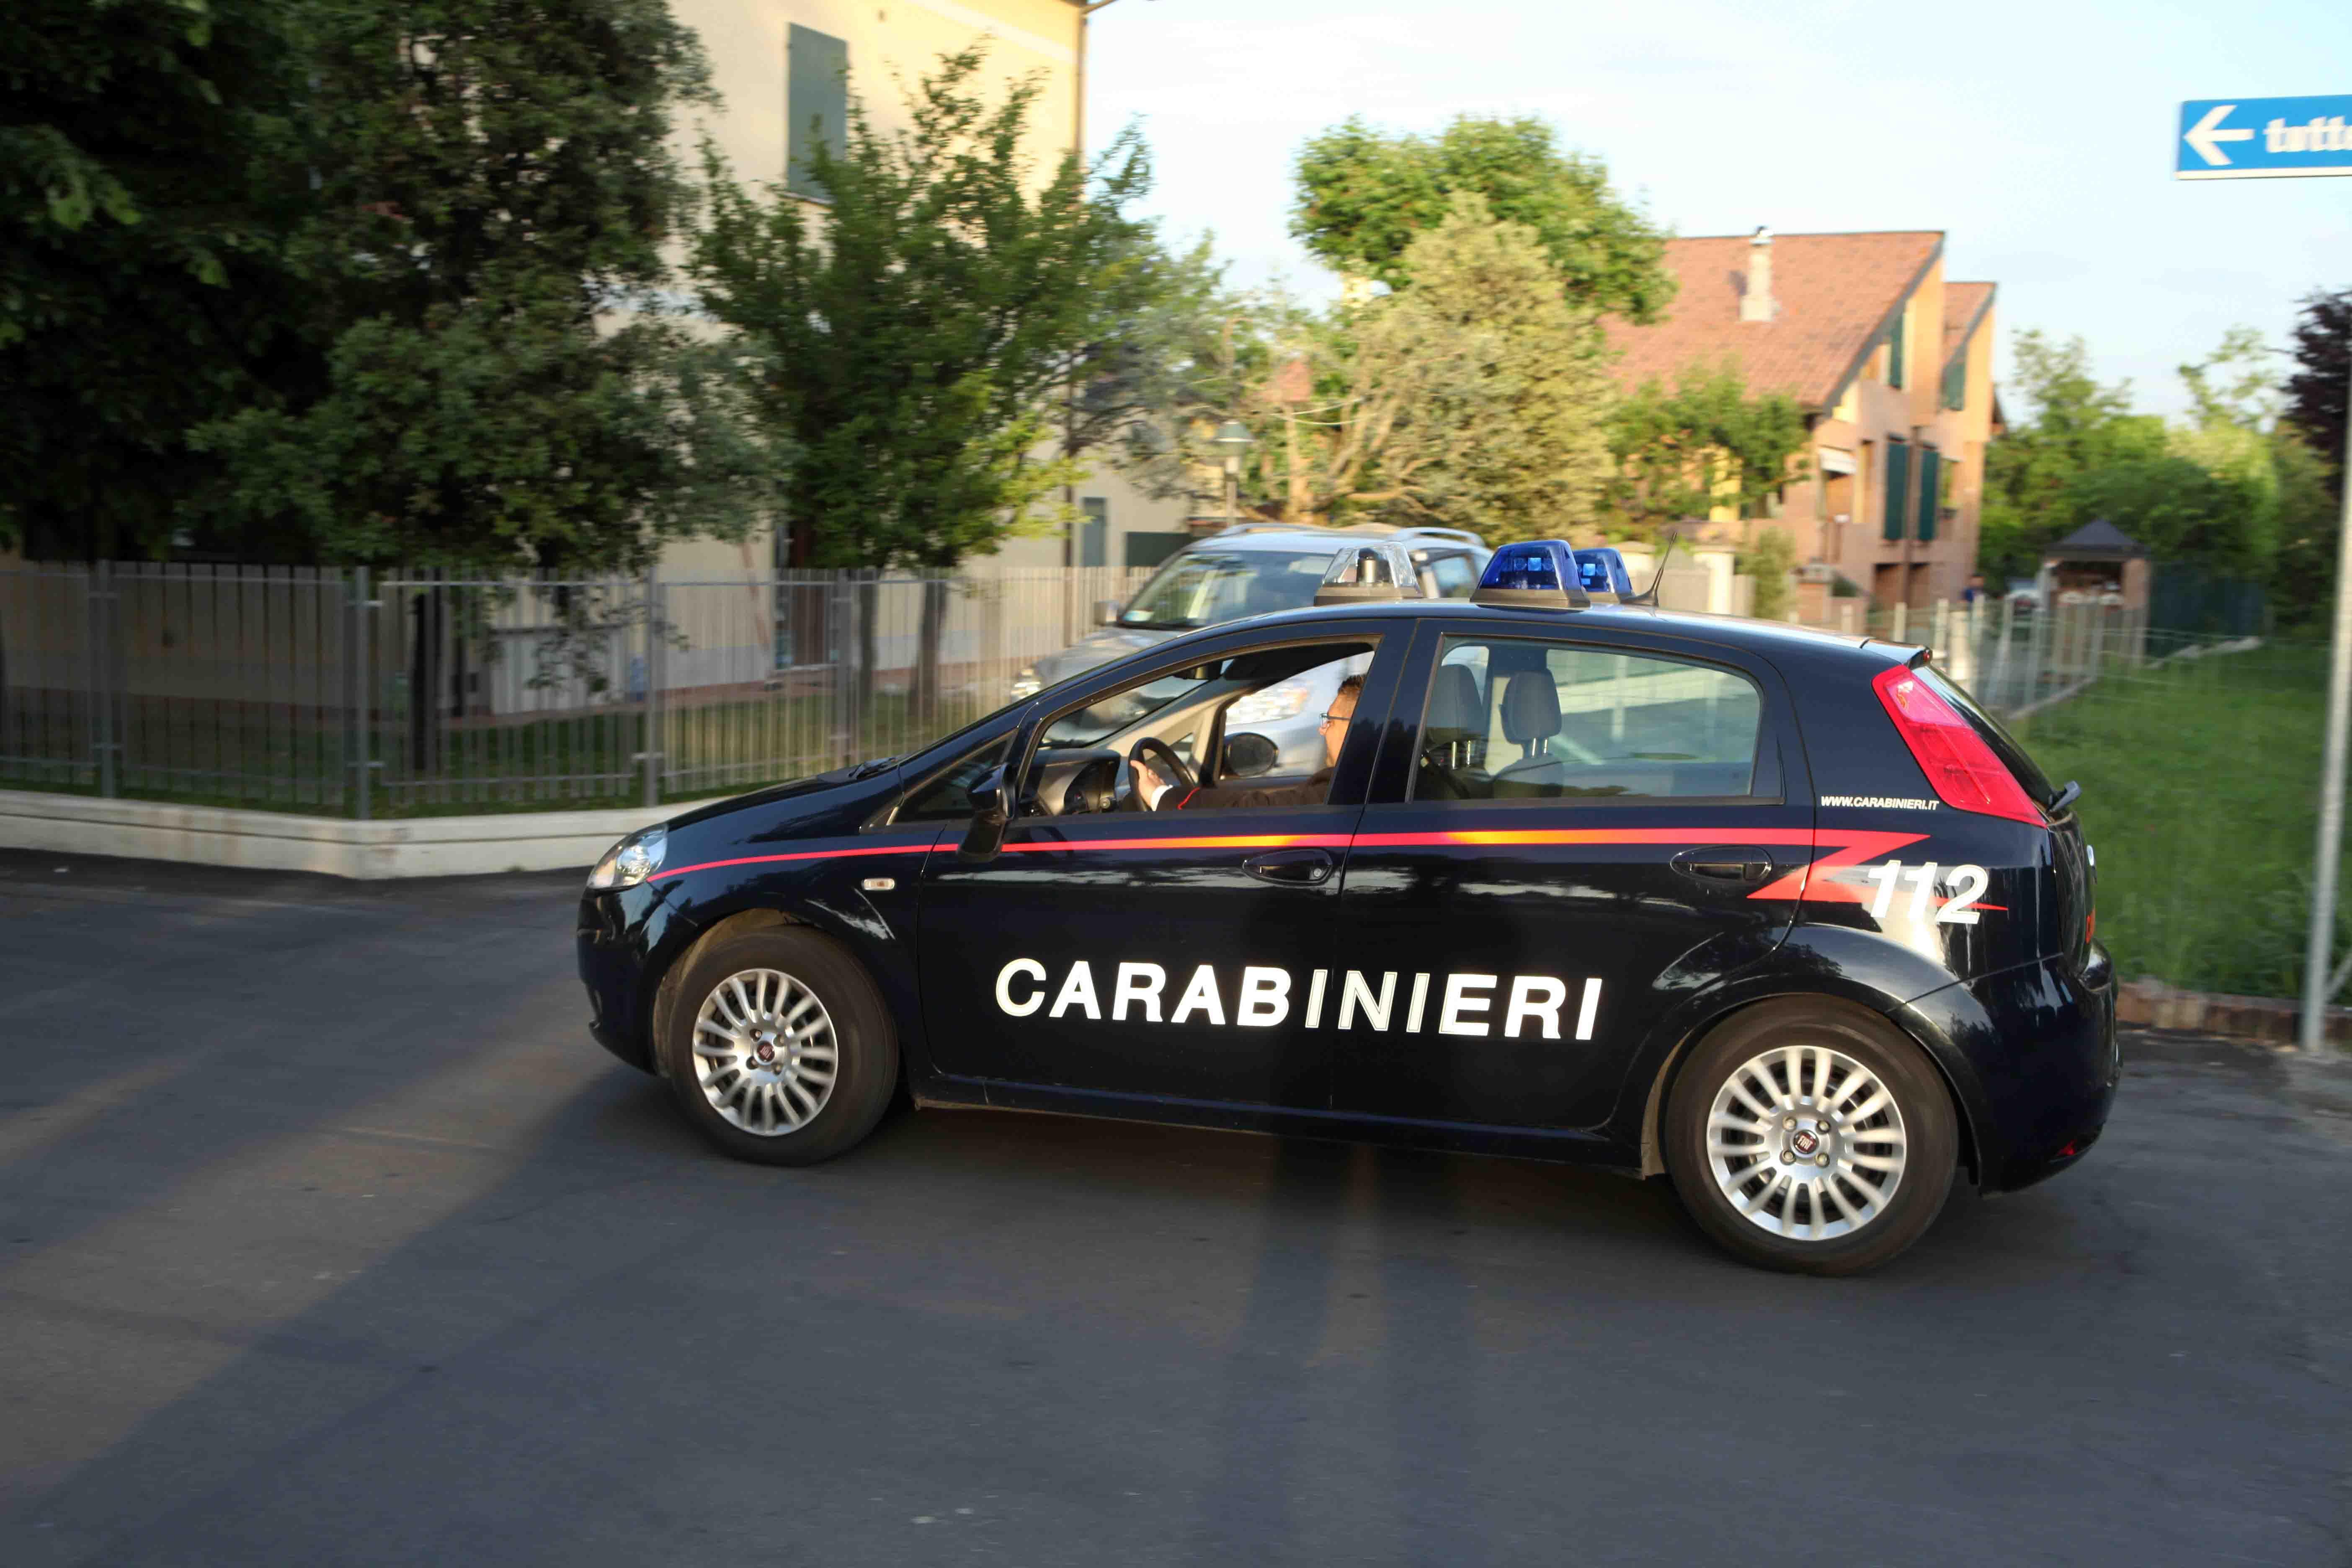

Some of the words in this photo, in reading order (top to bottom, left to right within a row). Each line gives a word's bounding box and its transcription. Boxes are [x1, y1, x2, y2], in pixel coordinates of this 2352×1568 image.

[1821, 796, 1939, 810] WWW.CARABINIERI.IT
[1867, 859, 1988, 924] 112
[995, 958, 1602, 1040] CARABINIERI
[1797, 1135, 1813, 1150] FIAT
